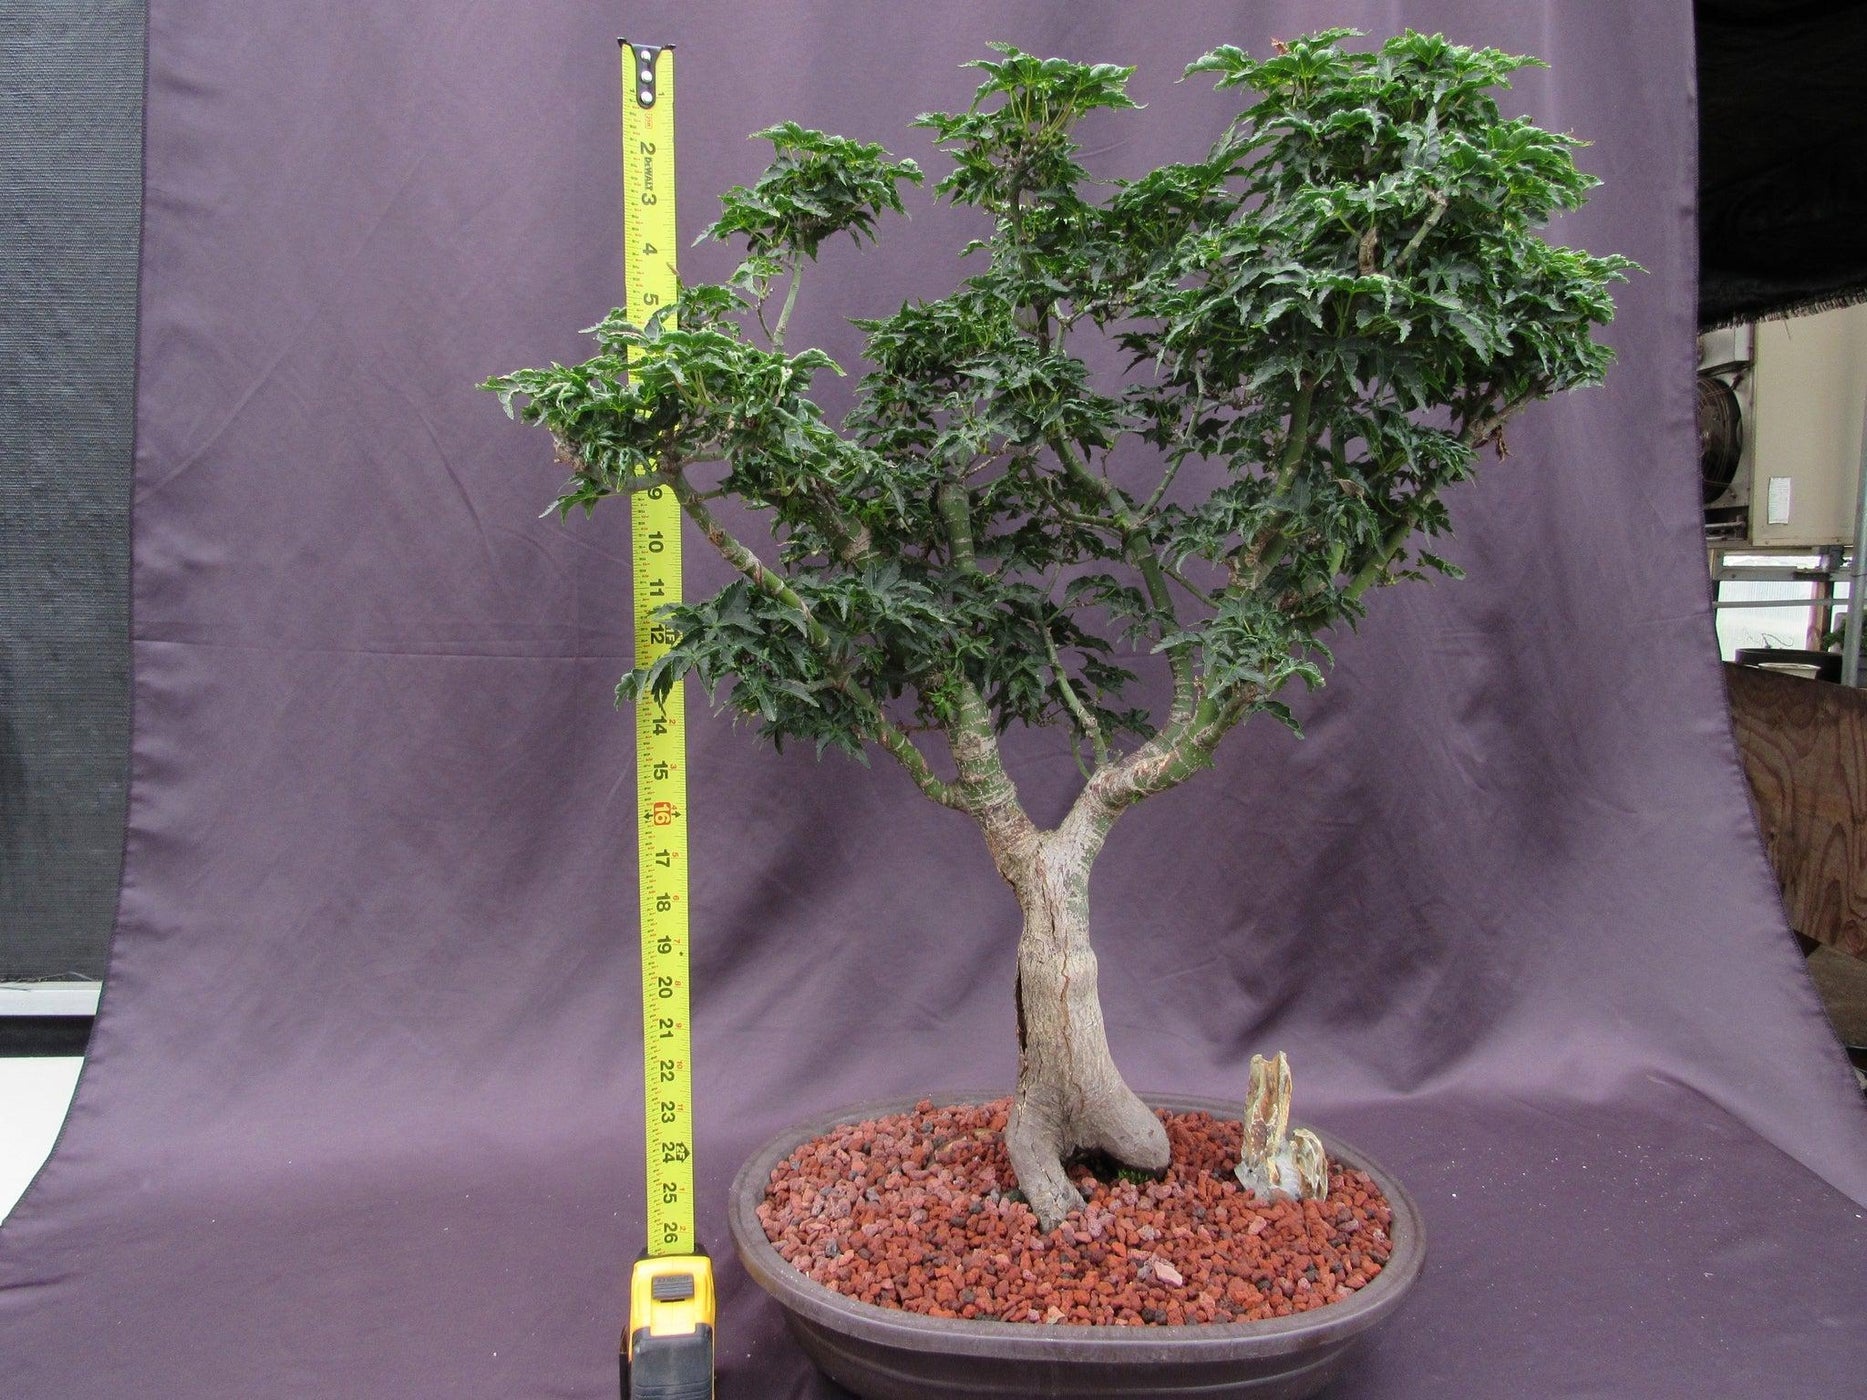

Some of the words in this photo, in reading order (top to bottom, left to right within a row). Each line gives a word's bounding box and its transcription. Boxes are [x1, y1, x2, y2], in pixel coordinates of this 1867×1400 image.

[640, 141, 656, 155] 2
[641, 192, 657, 206] 3
[643, 243, 658, 255] 4
[644, 292, 659, 306] 5
[648, 487, 663, 500] 9
[649, 531, 664, 553] 10
[650, 578, 665, 596] 11
[651, 624, 665, 644] 12
[652, 715, 667, 735] 14
[653, 760, 669, 781] 15
[655, 803, 670, 825] 16
[655, 849, 670, 868] 17
[656, 892, 671, 912] 18
[657, 935, 672, 955] 19
[658, 975, 673, 999] 20
[659, 1018, 674, 1039] 21
[660, 1059, 675, 1083] 22
[661, 1100, 676, 1124] 23
[662, 1141, 676, 1164] 24
[663, 1182, 677, 1204] 25
[664, 1222, 678, 1244] 26
